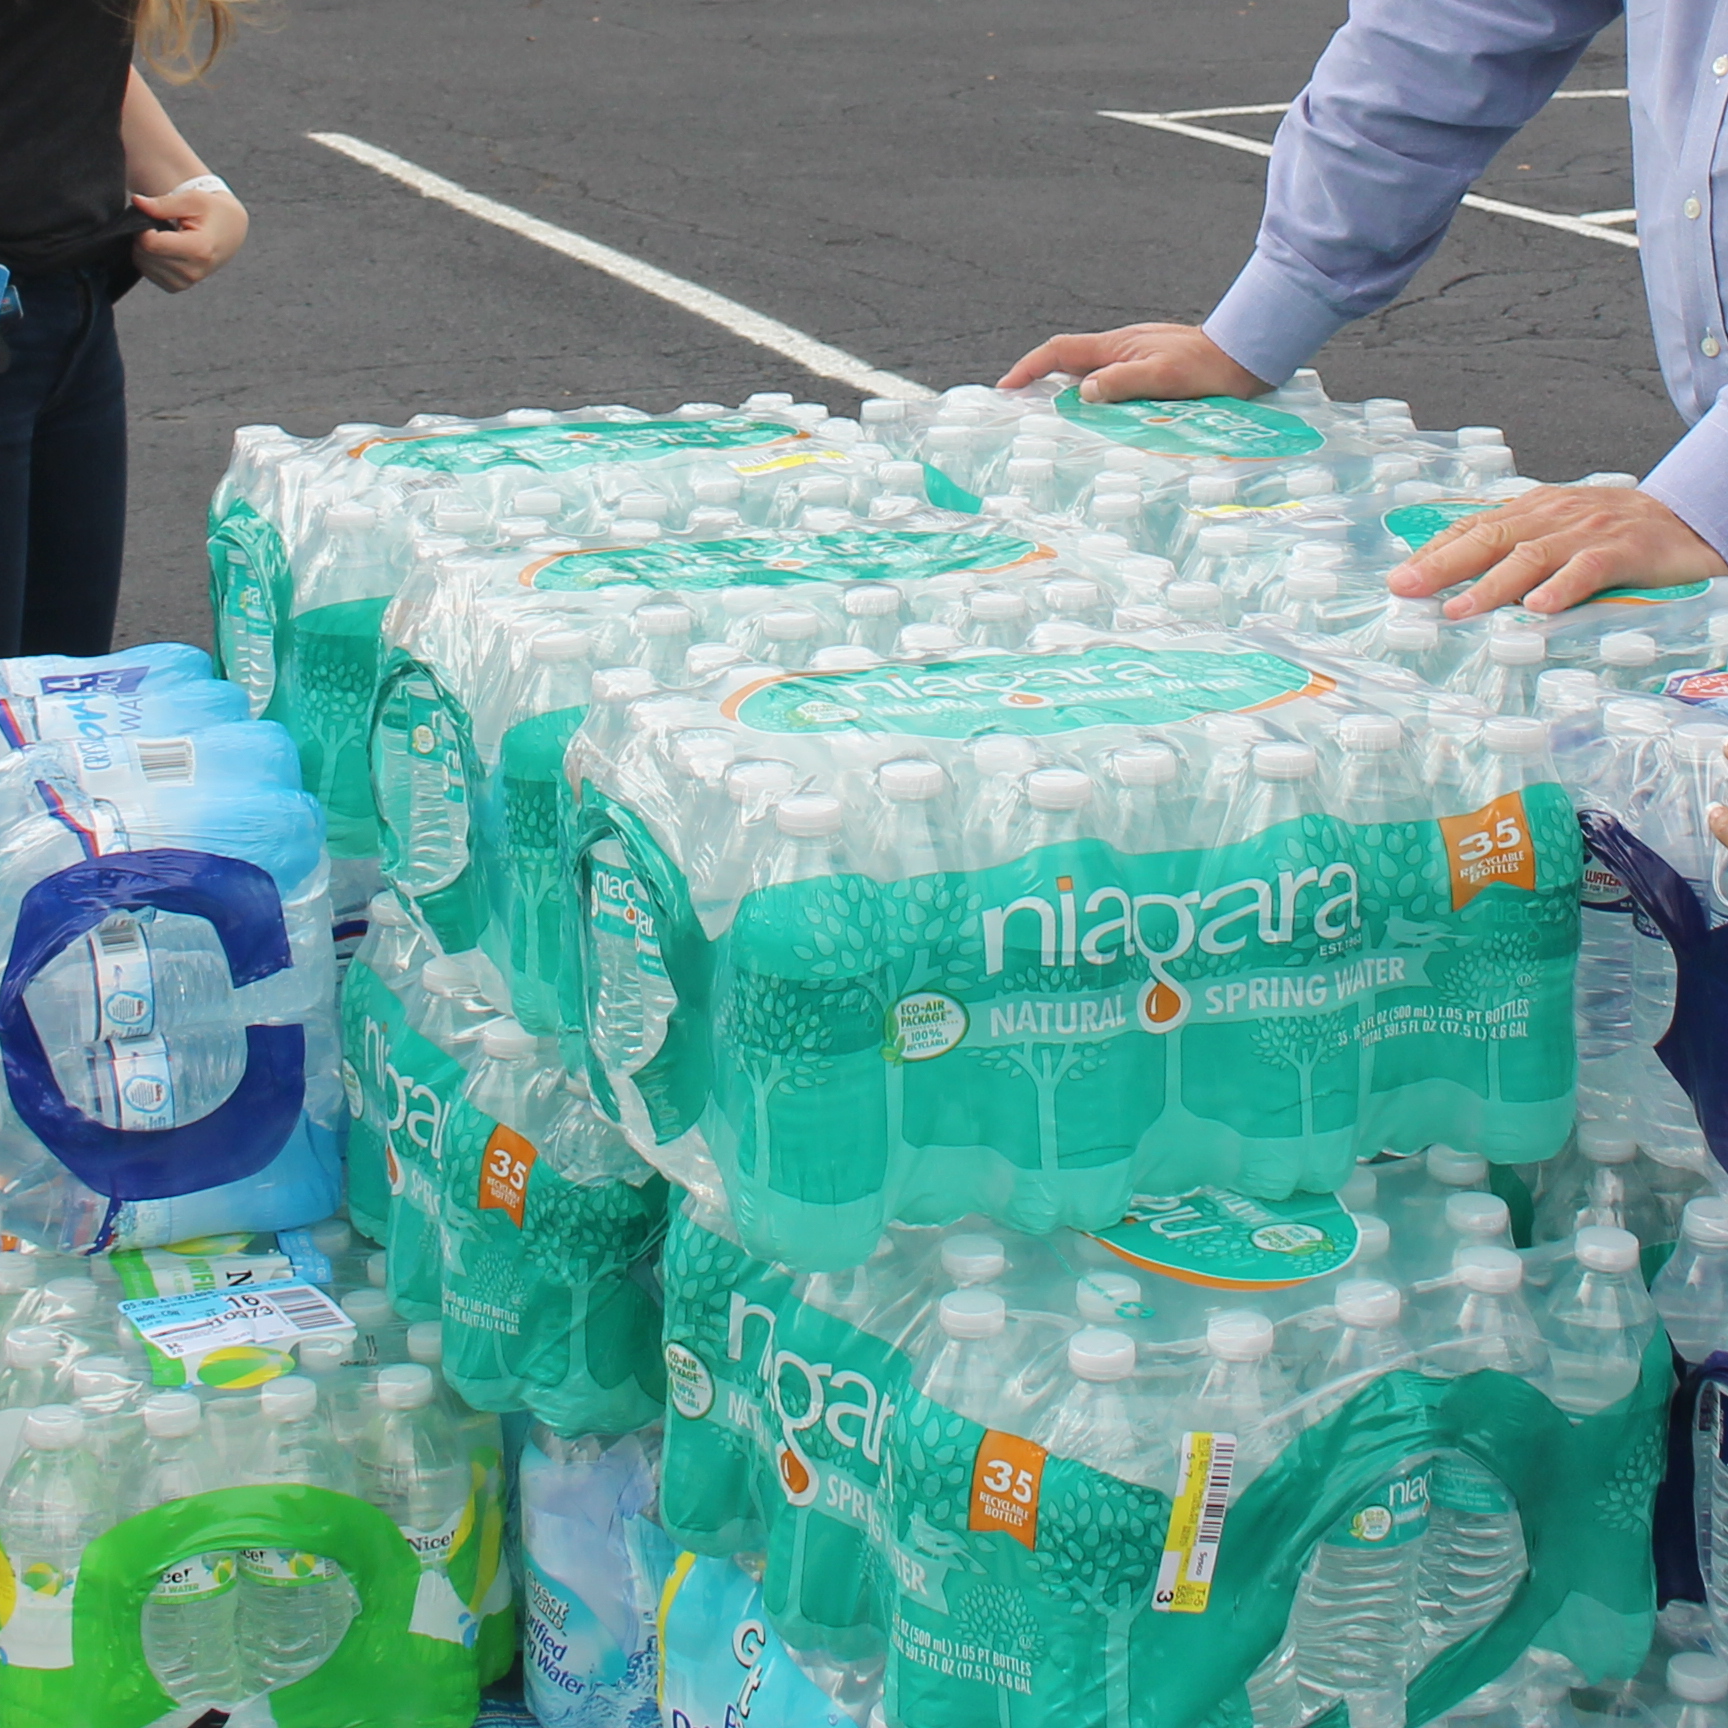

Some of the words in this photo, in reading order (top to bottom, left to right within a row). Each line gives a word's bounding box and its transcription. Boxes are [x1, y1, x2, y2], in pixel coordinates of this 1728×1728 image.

[839, 659, 1176, 708] niagara
[1458, 817, 1522, 861] 35
[1459, 849, 1525, 880] RECYCLABLE
[1469, 862, 1520, 884] BOTTLES
[982, 862, 1362, 1012] niagara
[900, 1000, 946, 1015] ECO-AIR
[989, 995, 1127, 1038] NATURAL
[1205, 975, 1328, 1016] SPRING
[1333, 956, 1406, 1000] WATER
[900, 1011, 948, 1028] PACKAGE
[1377, 1011, 1388, 1027] OZ
[1389, 1007, 1410, 1026] (500
[1413, 1004, 1435, 1022] mL)
[1437, 1006, 1462, 1023] 1.05
[1466, 1008, 1482, 1025] PT
[1485, 998, 1530, 1025] BOTTLES
[911, 1029, 943, 1043] 100%
[1409, 1021, 1420, 1036] FL
[1423, 1020, 1437, 1035] OZ
[1440, 1020, 1470, 1040] (17.5
[1489, 1023, 1507, 1039] 4.6
[1508, 1022, 1529, 1038] GAL
[489, 1148, 527, 1191] 35
[226, 1294, 262, 1310] 16
[983, 1460, 1034, 1504] 35
[979, 1491, 1031, 1521] RECYCLABLE
[984, 1505, 1023, 1528] BOTTLES
[407, 1529, 458, 1553] Nice!
[1156, 1590, 1174, 1604] 3
[910, 1626, 931, 1648] (500
[933, 1637, 953, 1658] mL)
[955, 1643, 976, 1662] 1.05
[977, 1647, 990, 1664] PT
[992, 1651, 1033, 1678] BOTTLES
[536, 1649, 587, 1696] Water
[905, 1641, 928, 1665] 591.5
[928, 1651, 940, 1671] FL
[941, 1657, 955, 1677] OZ
[957, 1661, 983, 1680] (17.5
[984, 1667, 997, 1686] L)
[997, 1672, 1013, 1689] 4.6
[1014, 1676, 1033, 1696] GAL
